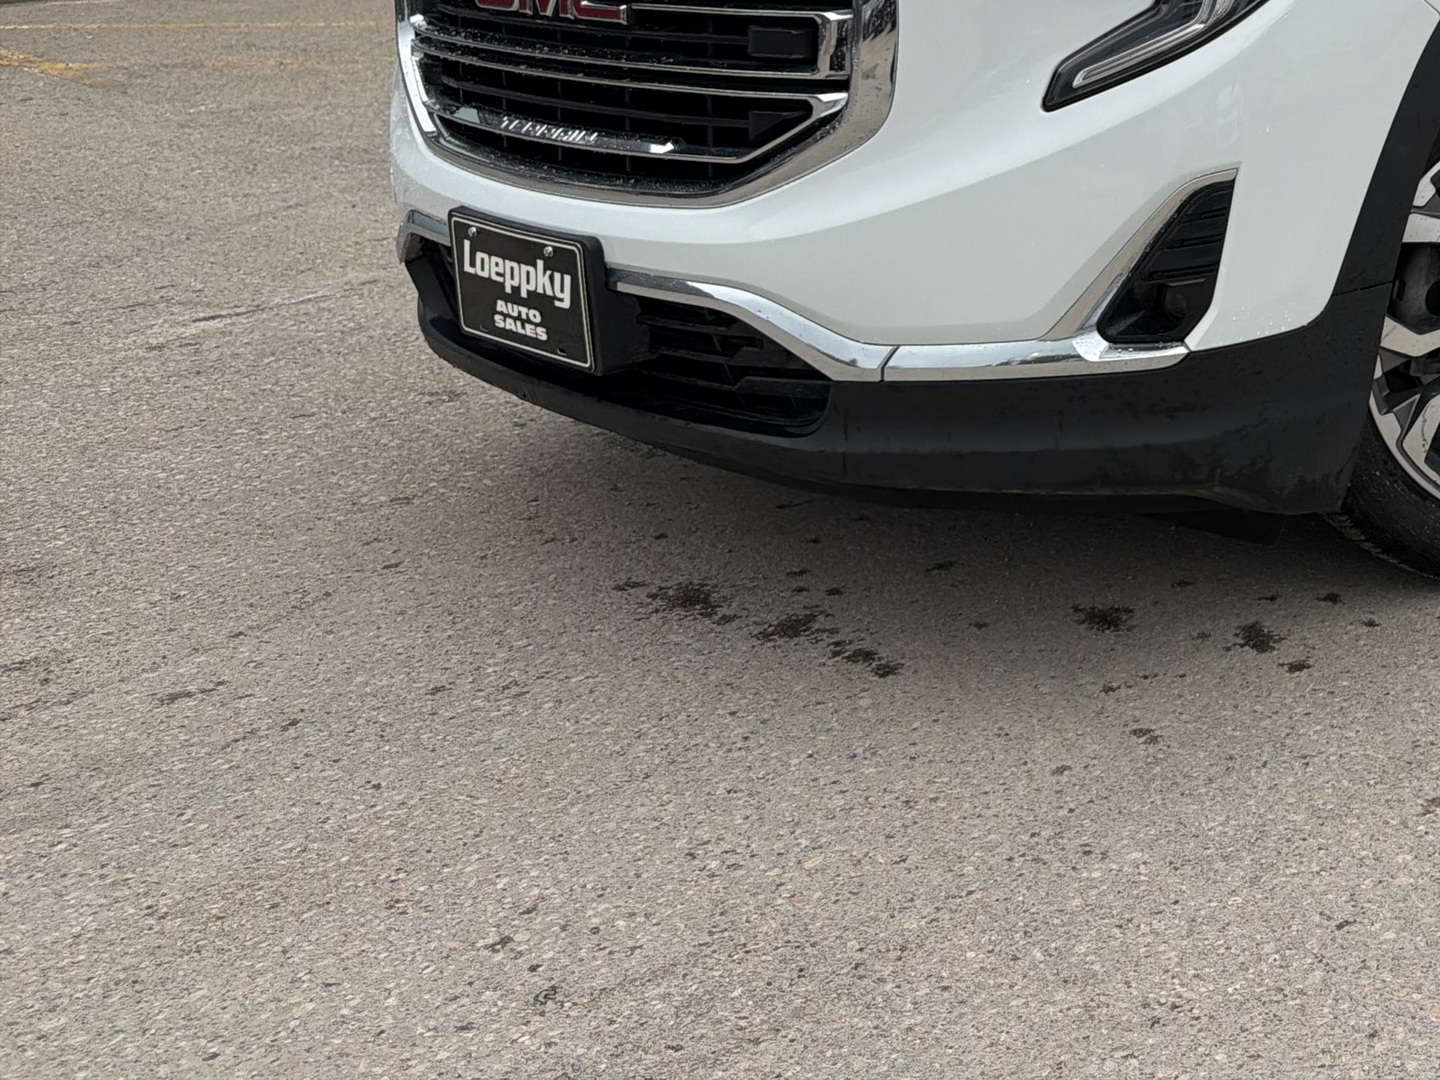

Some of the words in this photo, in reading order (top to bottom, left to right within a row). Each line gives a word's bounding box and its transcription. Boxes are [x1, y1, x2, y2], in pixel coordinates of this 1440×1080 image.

[463, 238, 572, 310] Loeppky
[496, 299, 542, 323] AUTO
[493, 314, 548, 341] SALES
